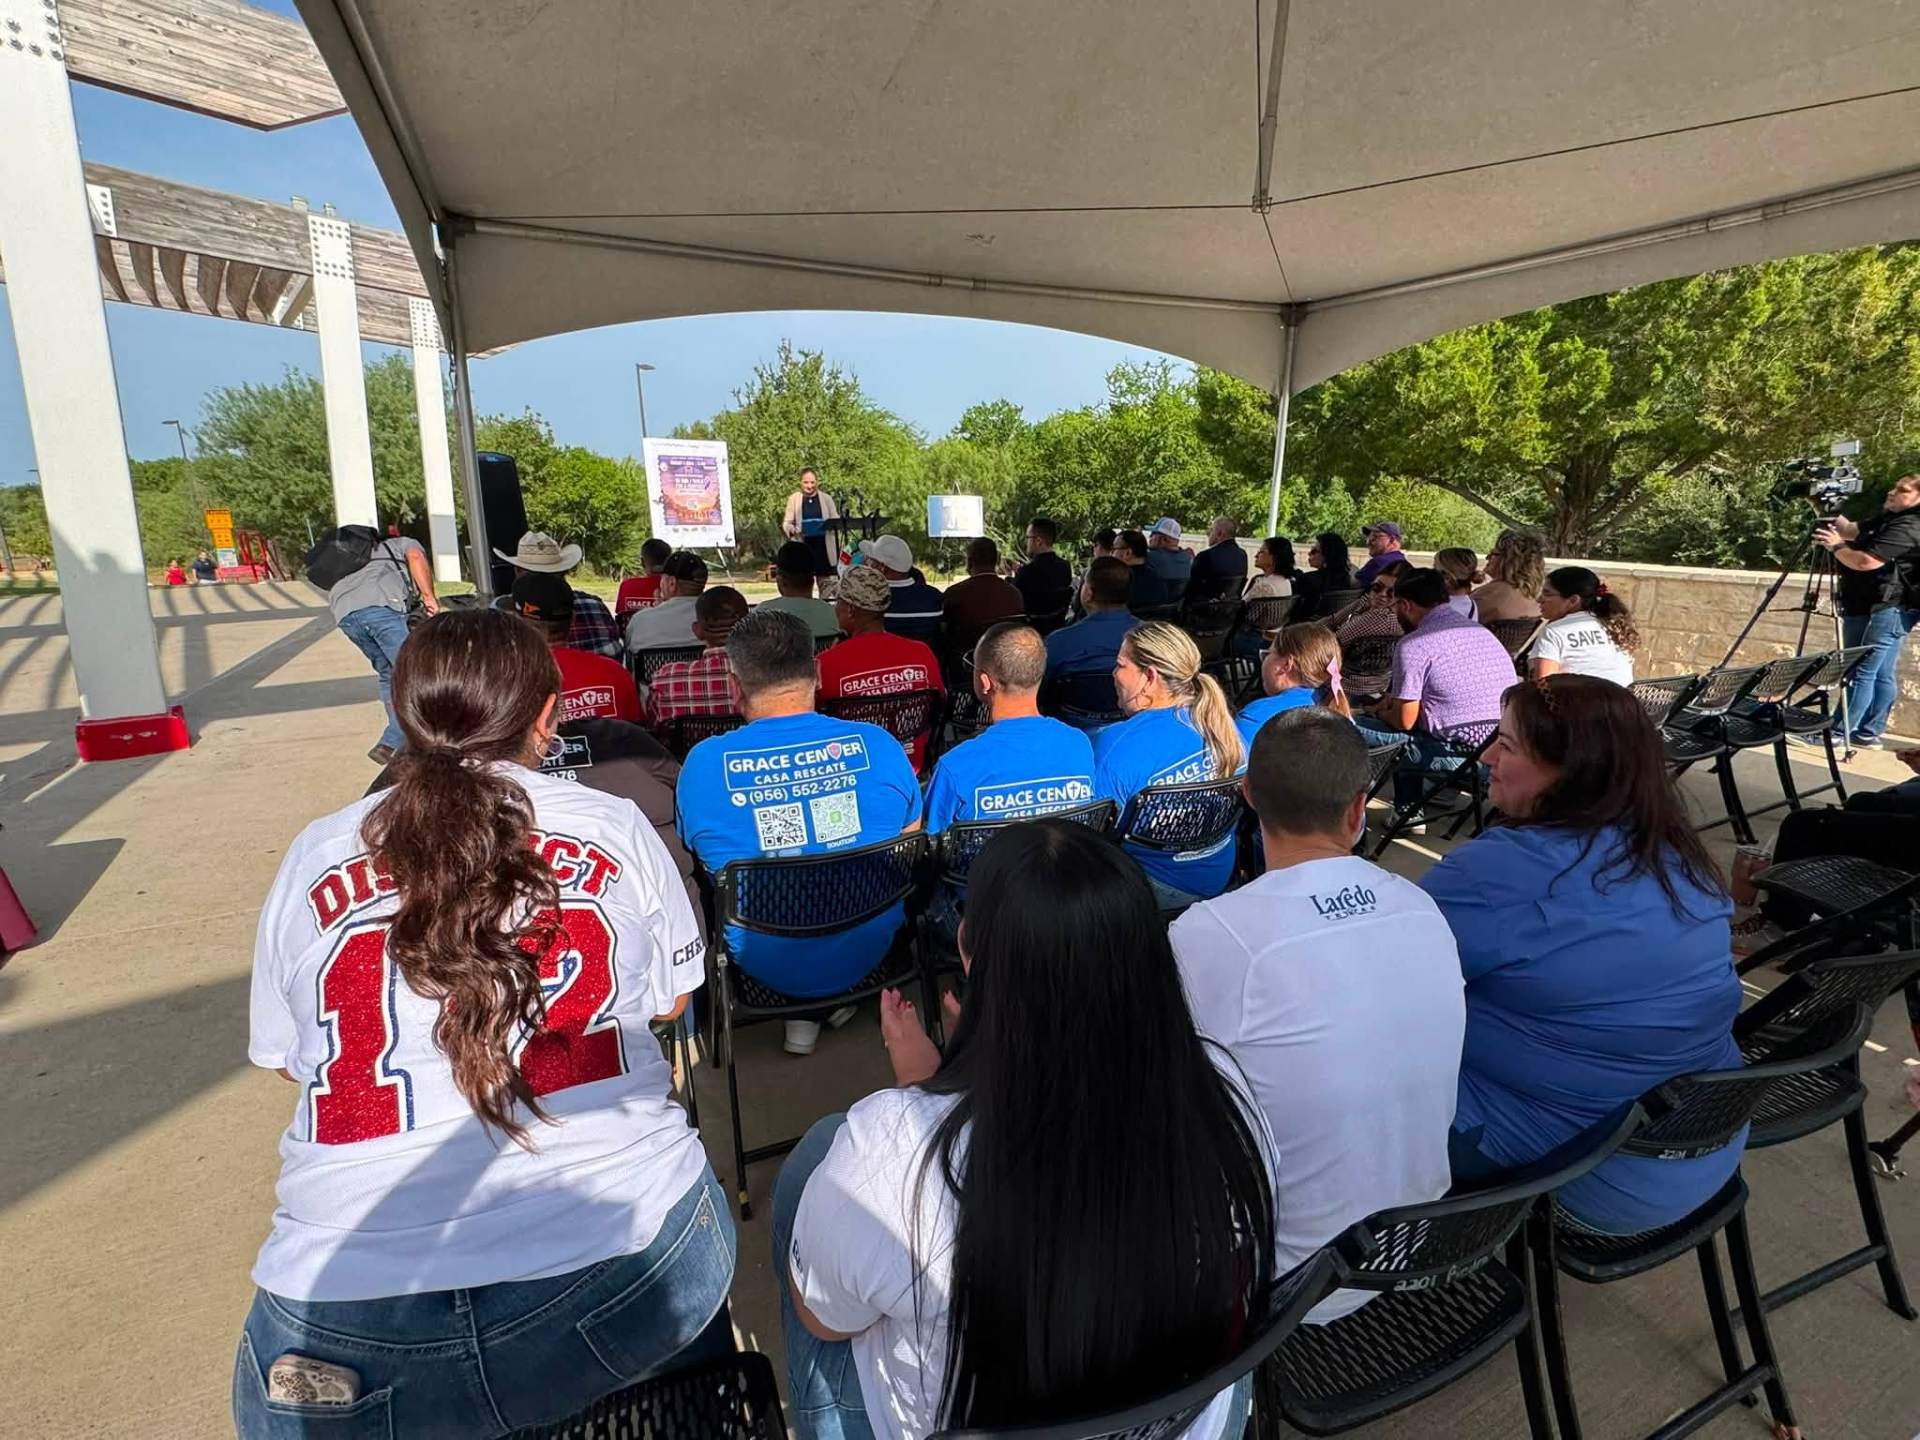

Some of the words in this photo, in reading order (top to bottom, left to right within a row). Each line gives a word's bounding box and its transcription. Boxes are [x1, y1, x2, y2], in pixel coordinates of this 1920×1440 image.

[1567, 630, 1605, 648] SAVE
[843, 675, 881, 692] GRACE
[729, 754, 791, 773] GRACE
[754, 772, 790, 785] CASA
[793, 762, 848, 780] RESCATE
[749, 787, 789, 806] (956)
[792, 774, 857, 797] 552-2276
[980, 789, 1033, 811] GRACE
[1309, 884, 1377, 916] Laredo
